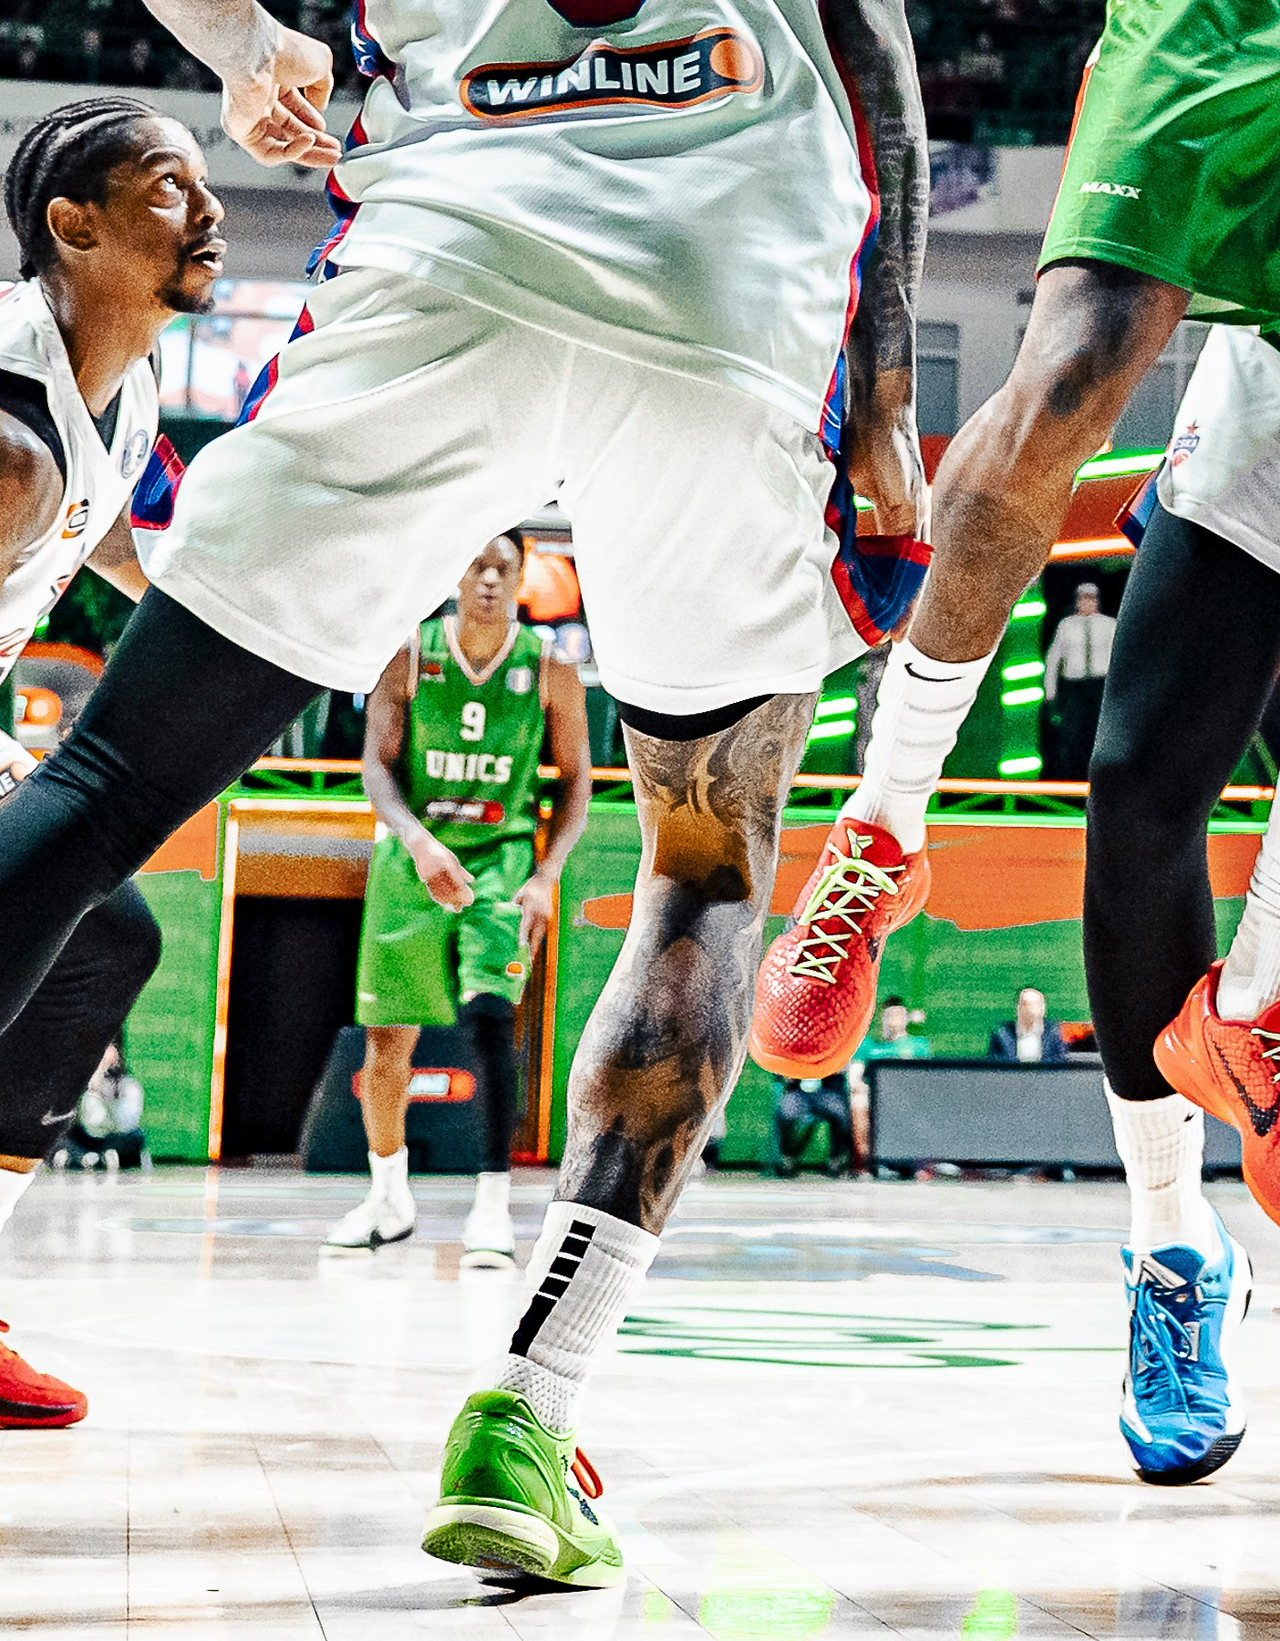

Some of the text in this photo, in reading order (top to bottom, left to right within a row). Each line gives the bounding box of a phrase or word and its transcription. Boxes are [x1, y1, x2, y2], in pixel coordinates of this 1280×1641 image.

[485, 49, 704, 106] WINLINE
[1080, 181, 1142, 200] MAXX
[459, 701, 487, 742] 9
[425, 749, 514, 784] UNICS
